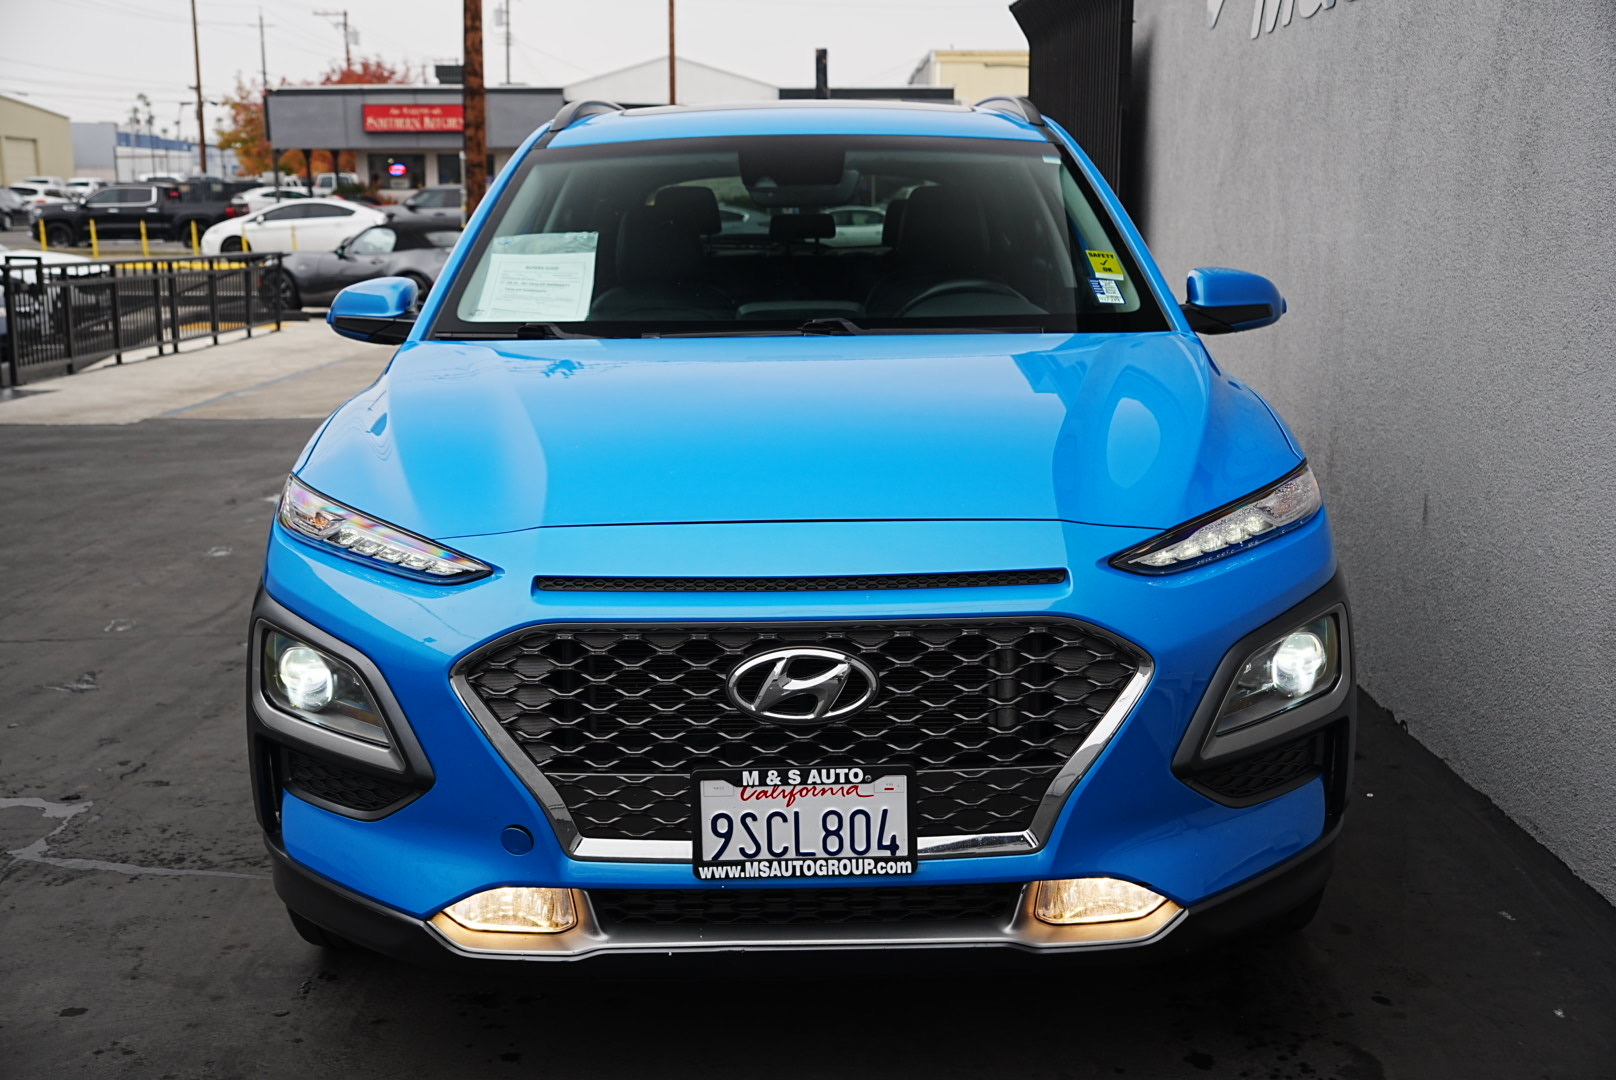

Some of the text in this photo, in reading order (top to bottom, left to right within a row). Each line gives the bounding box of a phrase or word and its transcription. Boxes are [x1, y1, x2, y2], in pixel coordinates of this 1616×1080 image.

[742, 768, 864, 786] M & S AUTO
[740, 785, 875, 808] California
[710, 808, 900, 861] 9SCL804
[698, 858, 912, 879] www.MSAUTOGROUP.com
